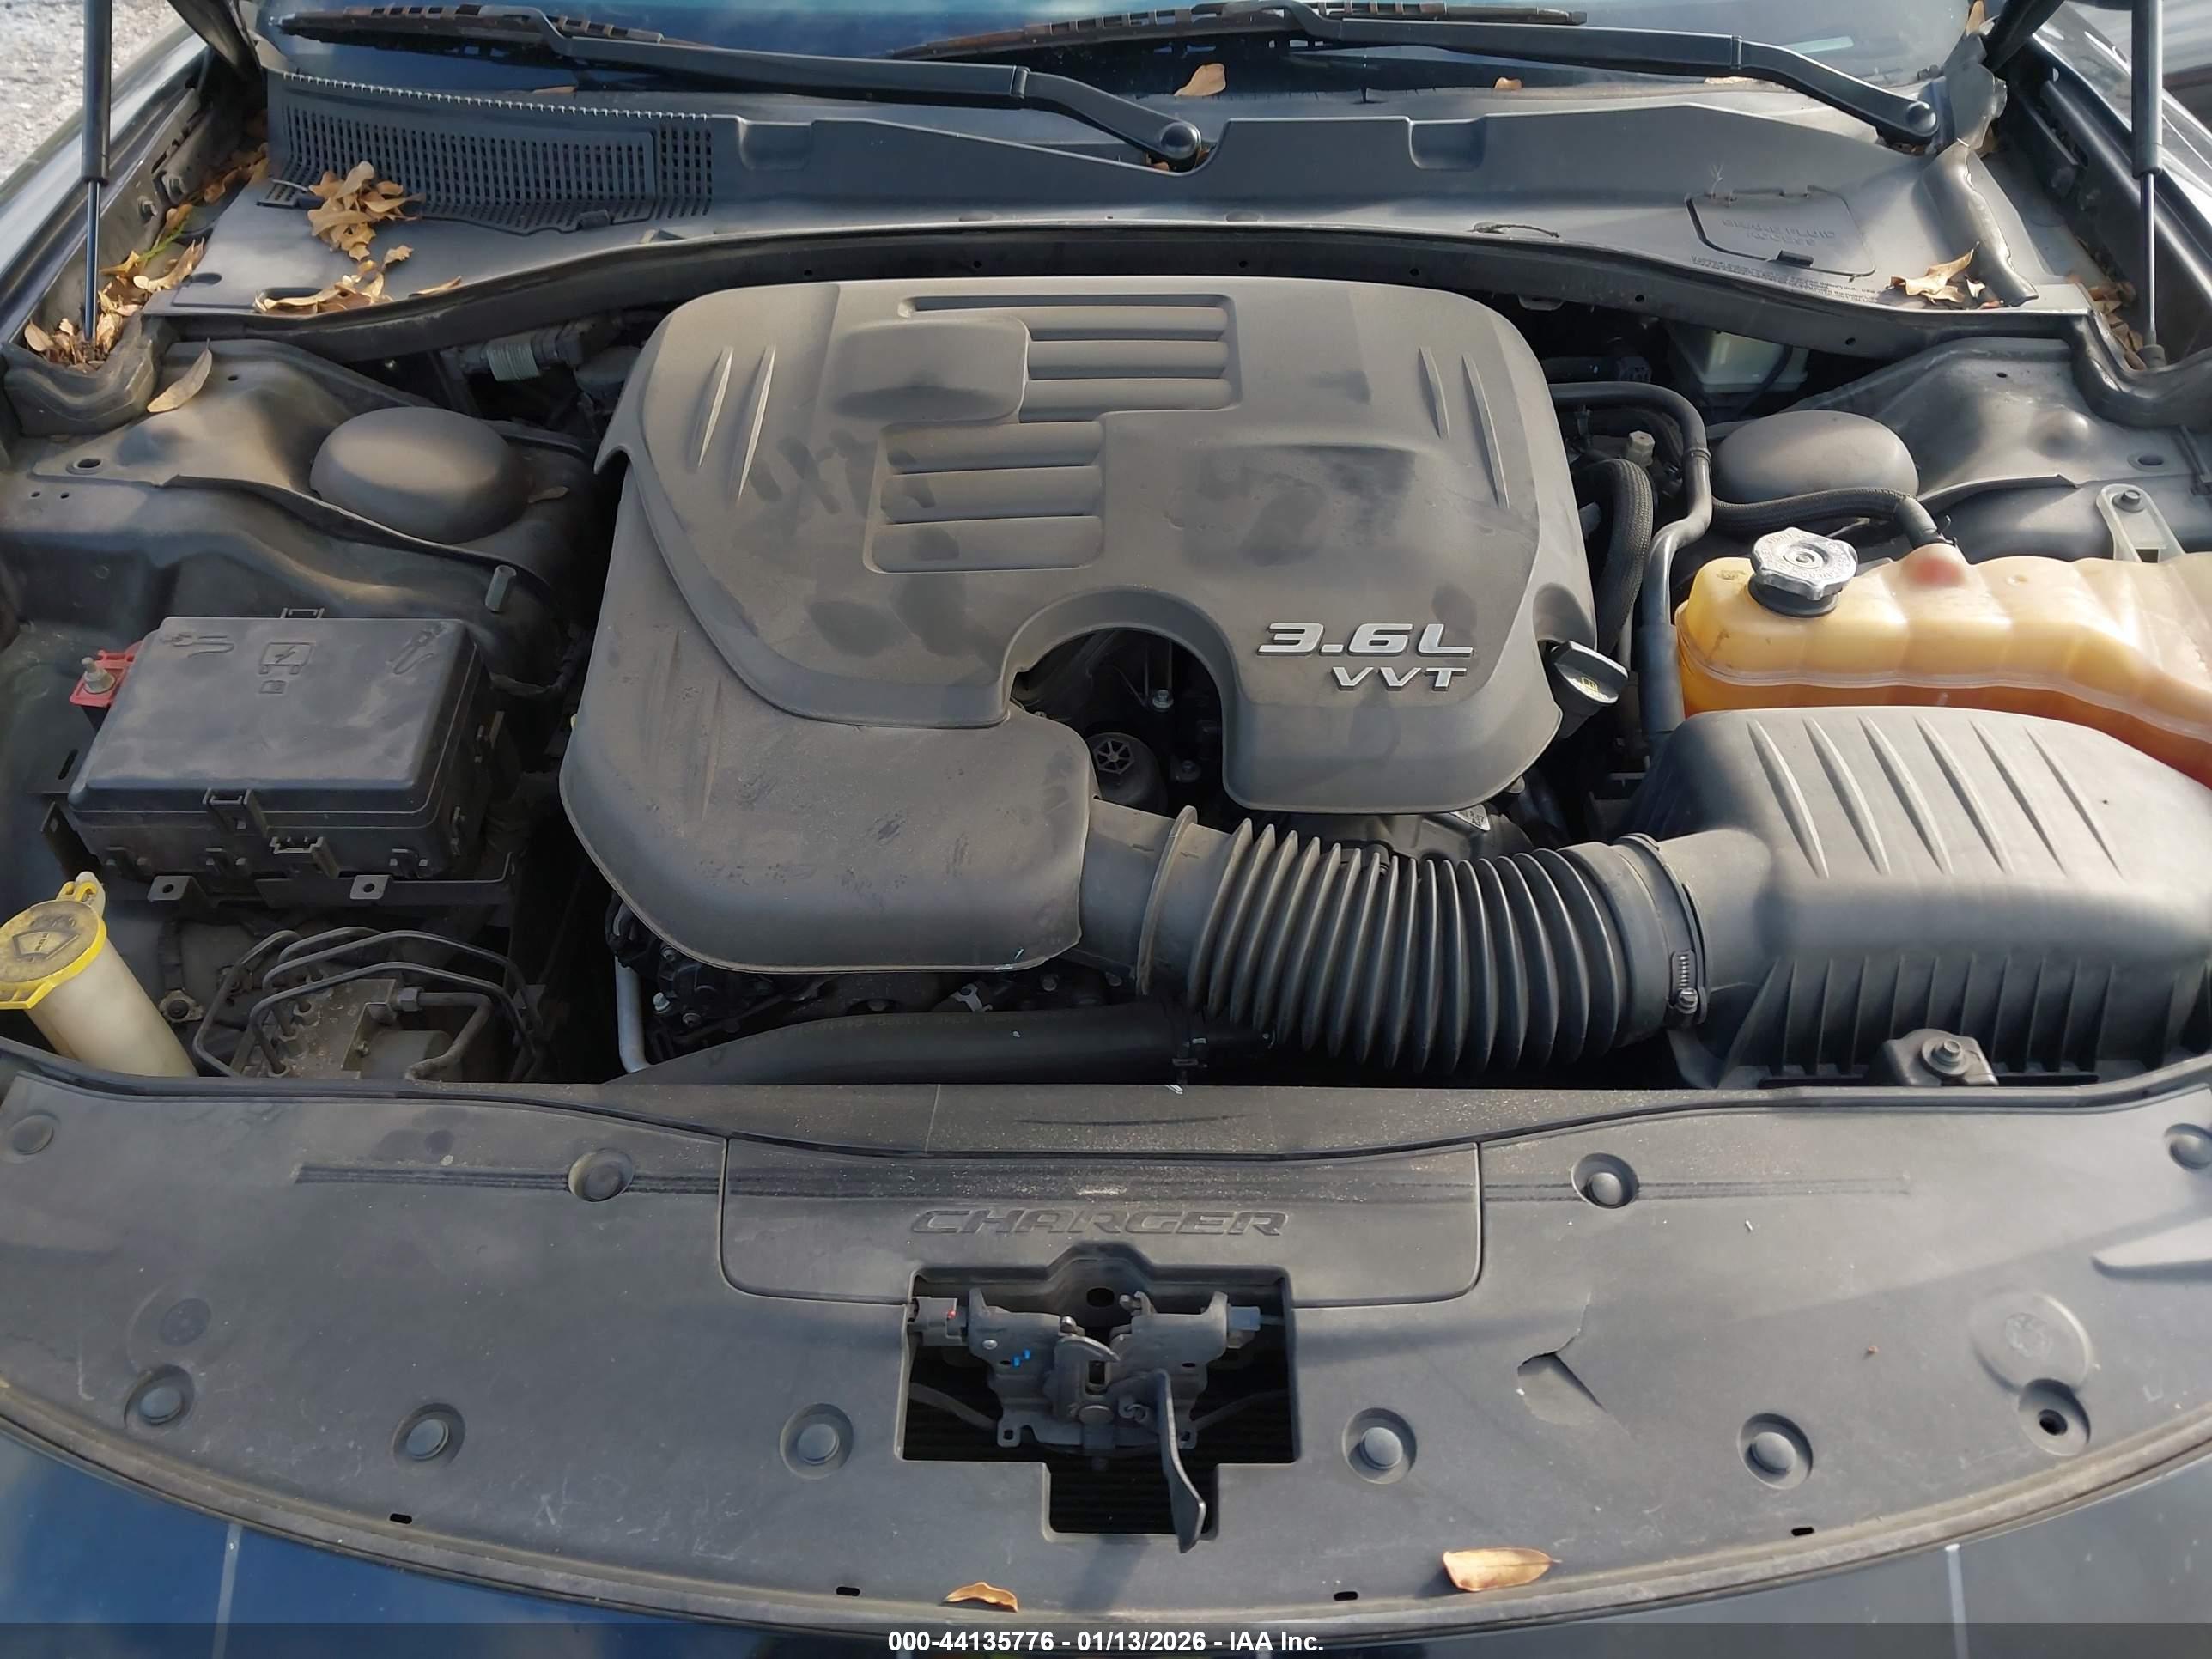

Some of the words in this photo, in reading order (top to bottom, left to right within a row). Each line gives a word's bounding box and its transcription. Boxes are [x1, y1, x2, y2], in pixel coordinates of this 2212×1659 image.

[1257, 623, 1474, 656] 3.6L
[1332, 666, 1468, 691] VVT
[911, 1209, 1288, 1236] CHARGER
